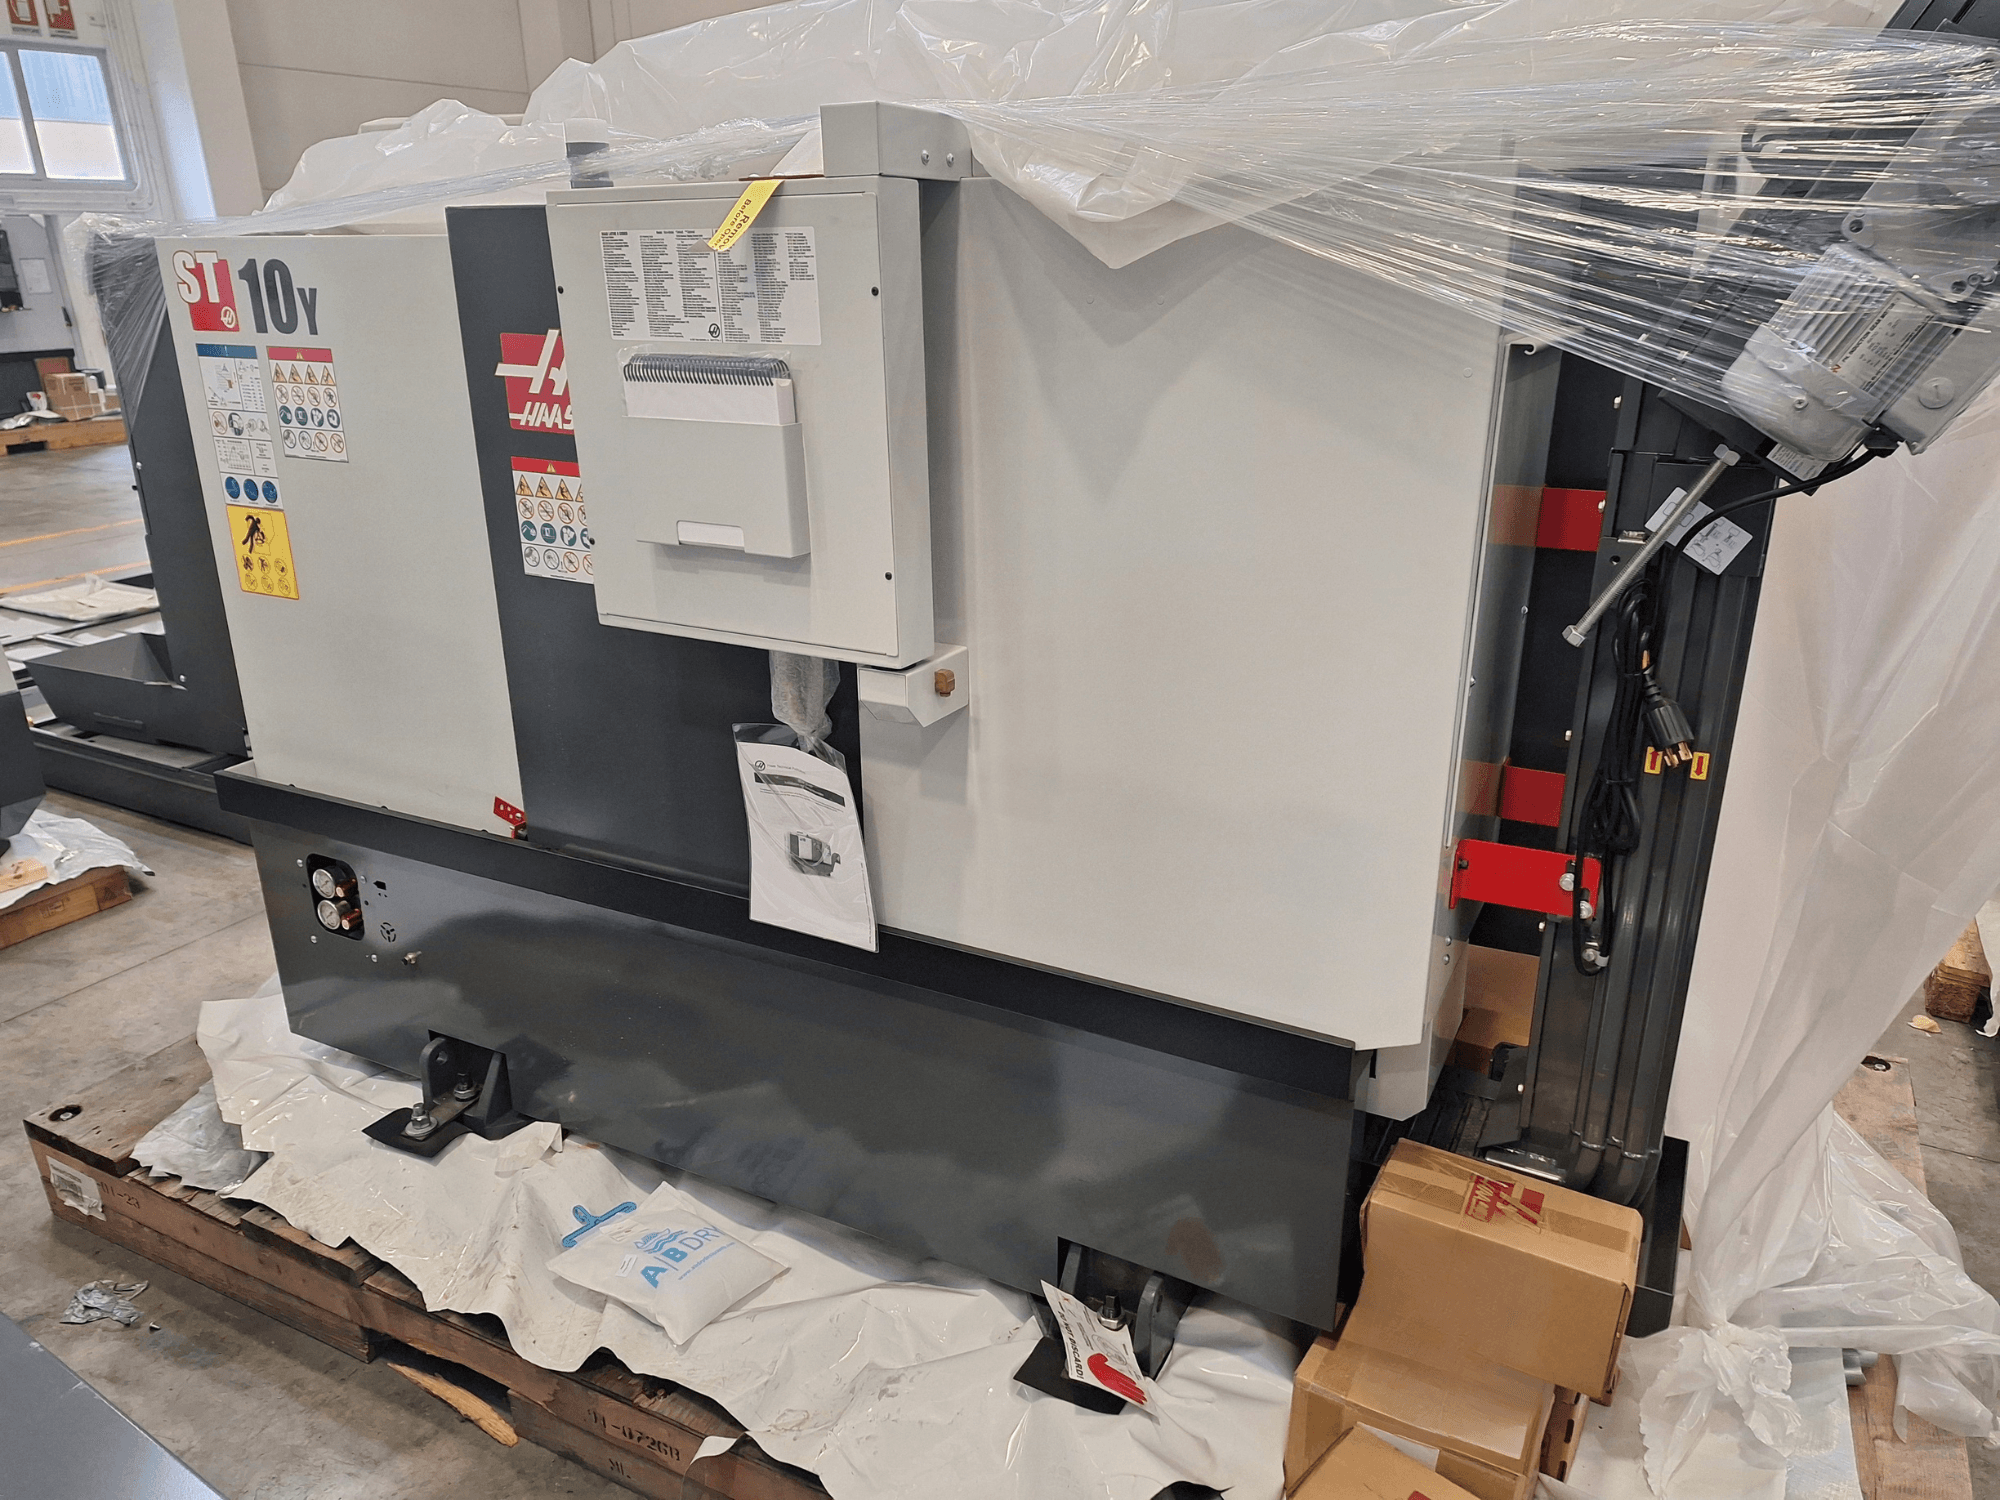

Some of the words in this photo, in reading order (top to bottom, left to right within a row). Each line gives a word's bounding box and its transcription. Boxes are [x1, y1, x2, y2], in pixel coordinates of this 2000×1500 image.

[729, 198, 752, 227] Before
[172, 250, 220, 304] ST
[237, 258, 319, 335] 10Y
[1848, 331, 1870, 355] INDUCTION
[1869, 318, 1881, 332] GEAR
[508, 401, 575, 430] HAAS
[1057, 1310, 1067, 1323] DO
[1062, 1320, 1075, 1338] NOT
[1068, 1337, 1085, 1380] DISCARD!
